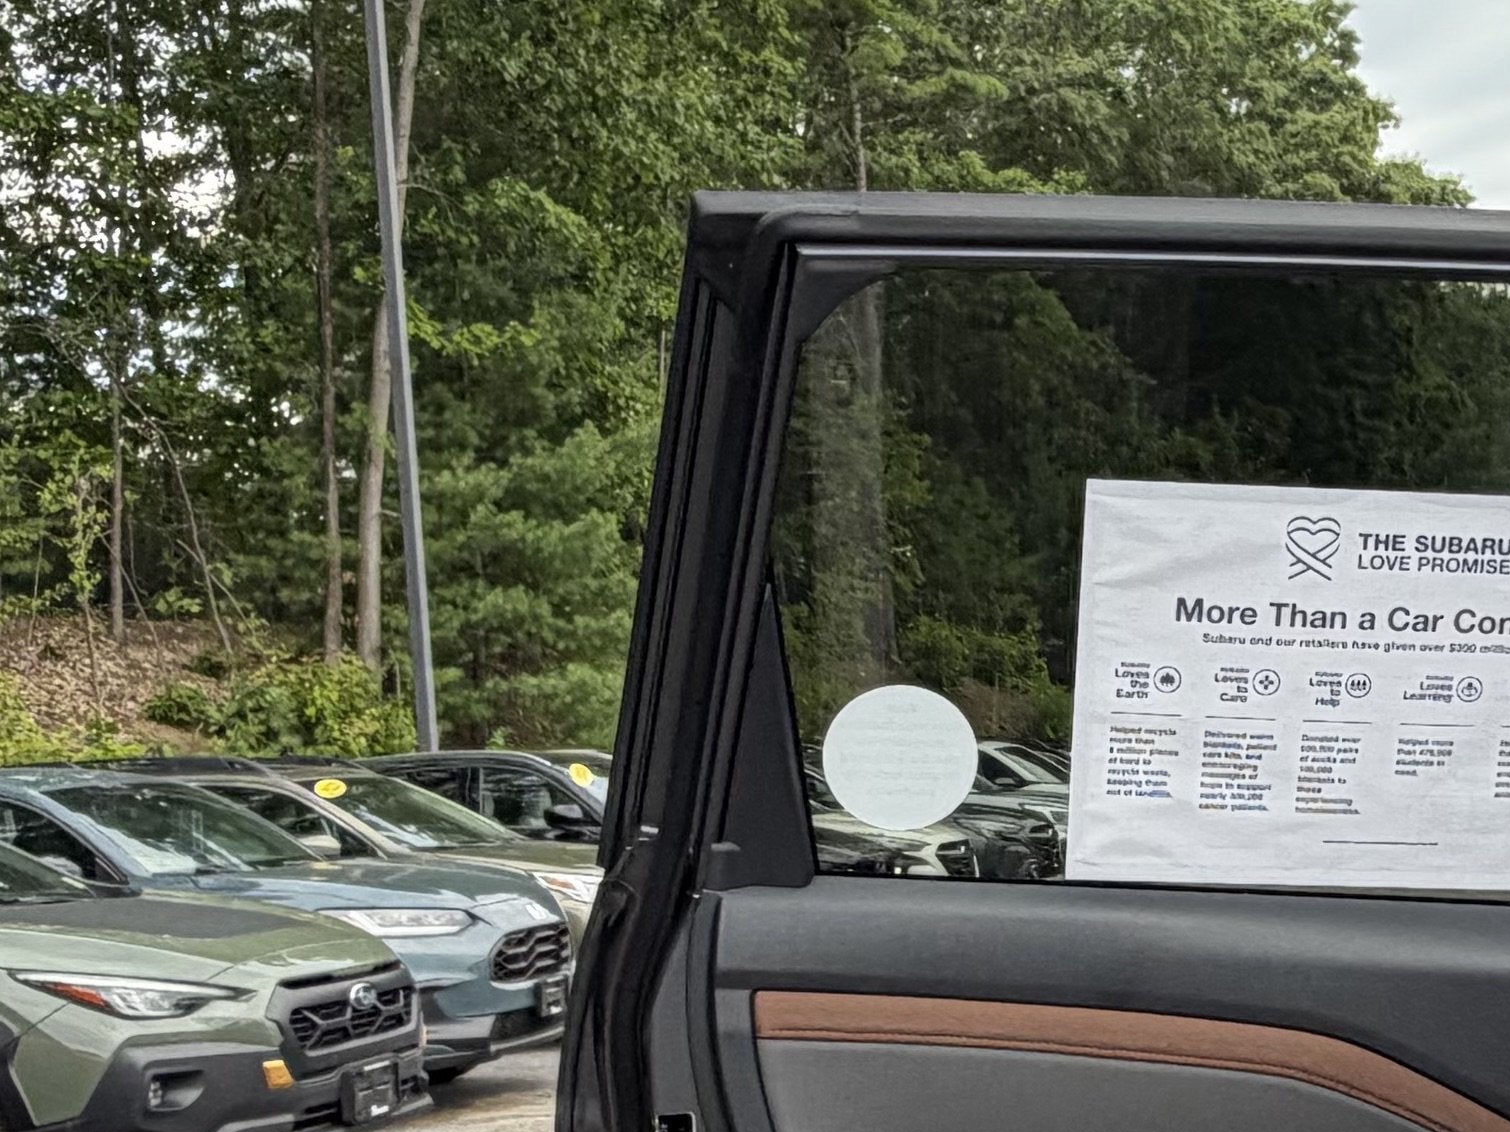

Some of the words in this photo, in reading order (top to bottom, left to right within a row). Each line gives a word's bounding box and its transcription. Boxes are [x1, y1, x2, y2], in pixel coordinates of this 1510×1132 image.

[1358, 532, 1406, 552] THE
[1357, 554, 1411, 571] LOVE
[1417, 556, 1510, 575] PROMISE
[1175, 597, 1258, 625] More
[1269, 602, 1348, 630] Than
[1358, 611, 1376, 631] a
[1388, 606, 1444, 633] Car
[1202, 632, 1246, 645] Subaru
[1249, 636, 1272, 647] and
[1276, 638, 1297, 647] our
[1384, 641, 1416, 653] given
[1419, 644, 1445, 653] over
[1115, 667, 1150, 679] Loves
[1116, 688, 1149, 699] Earth
